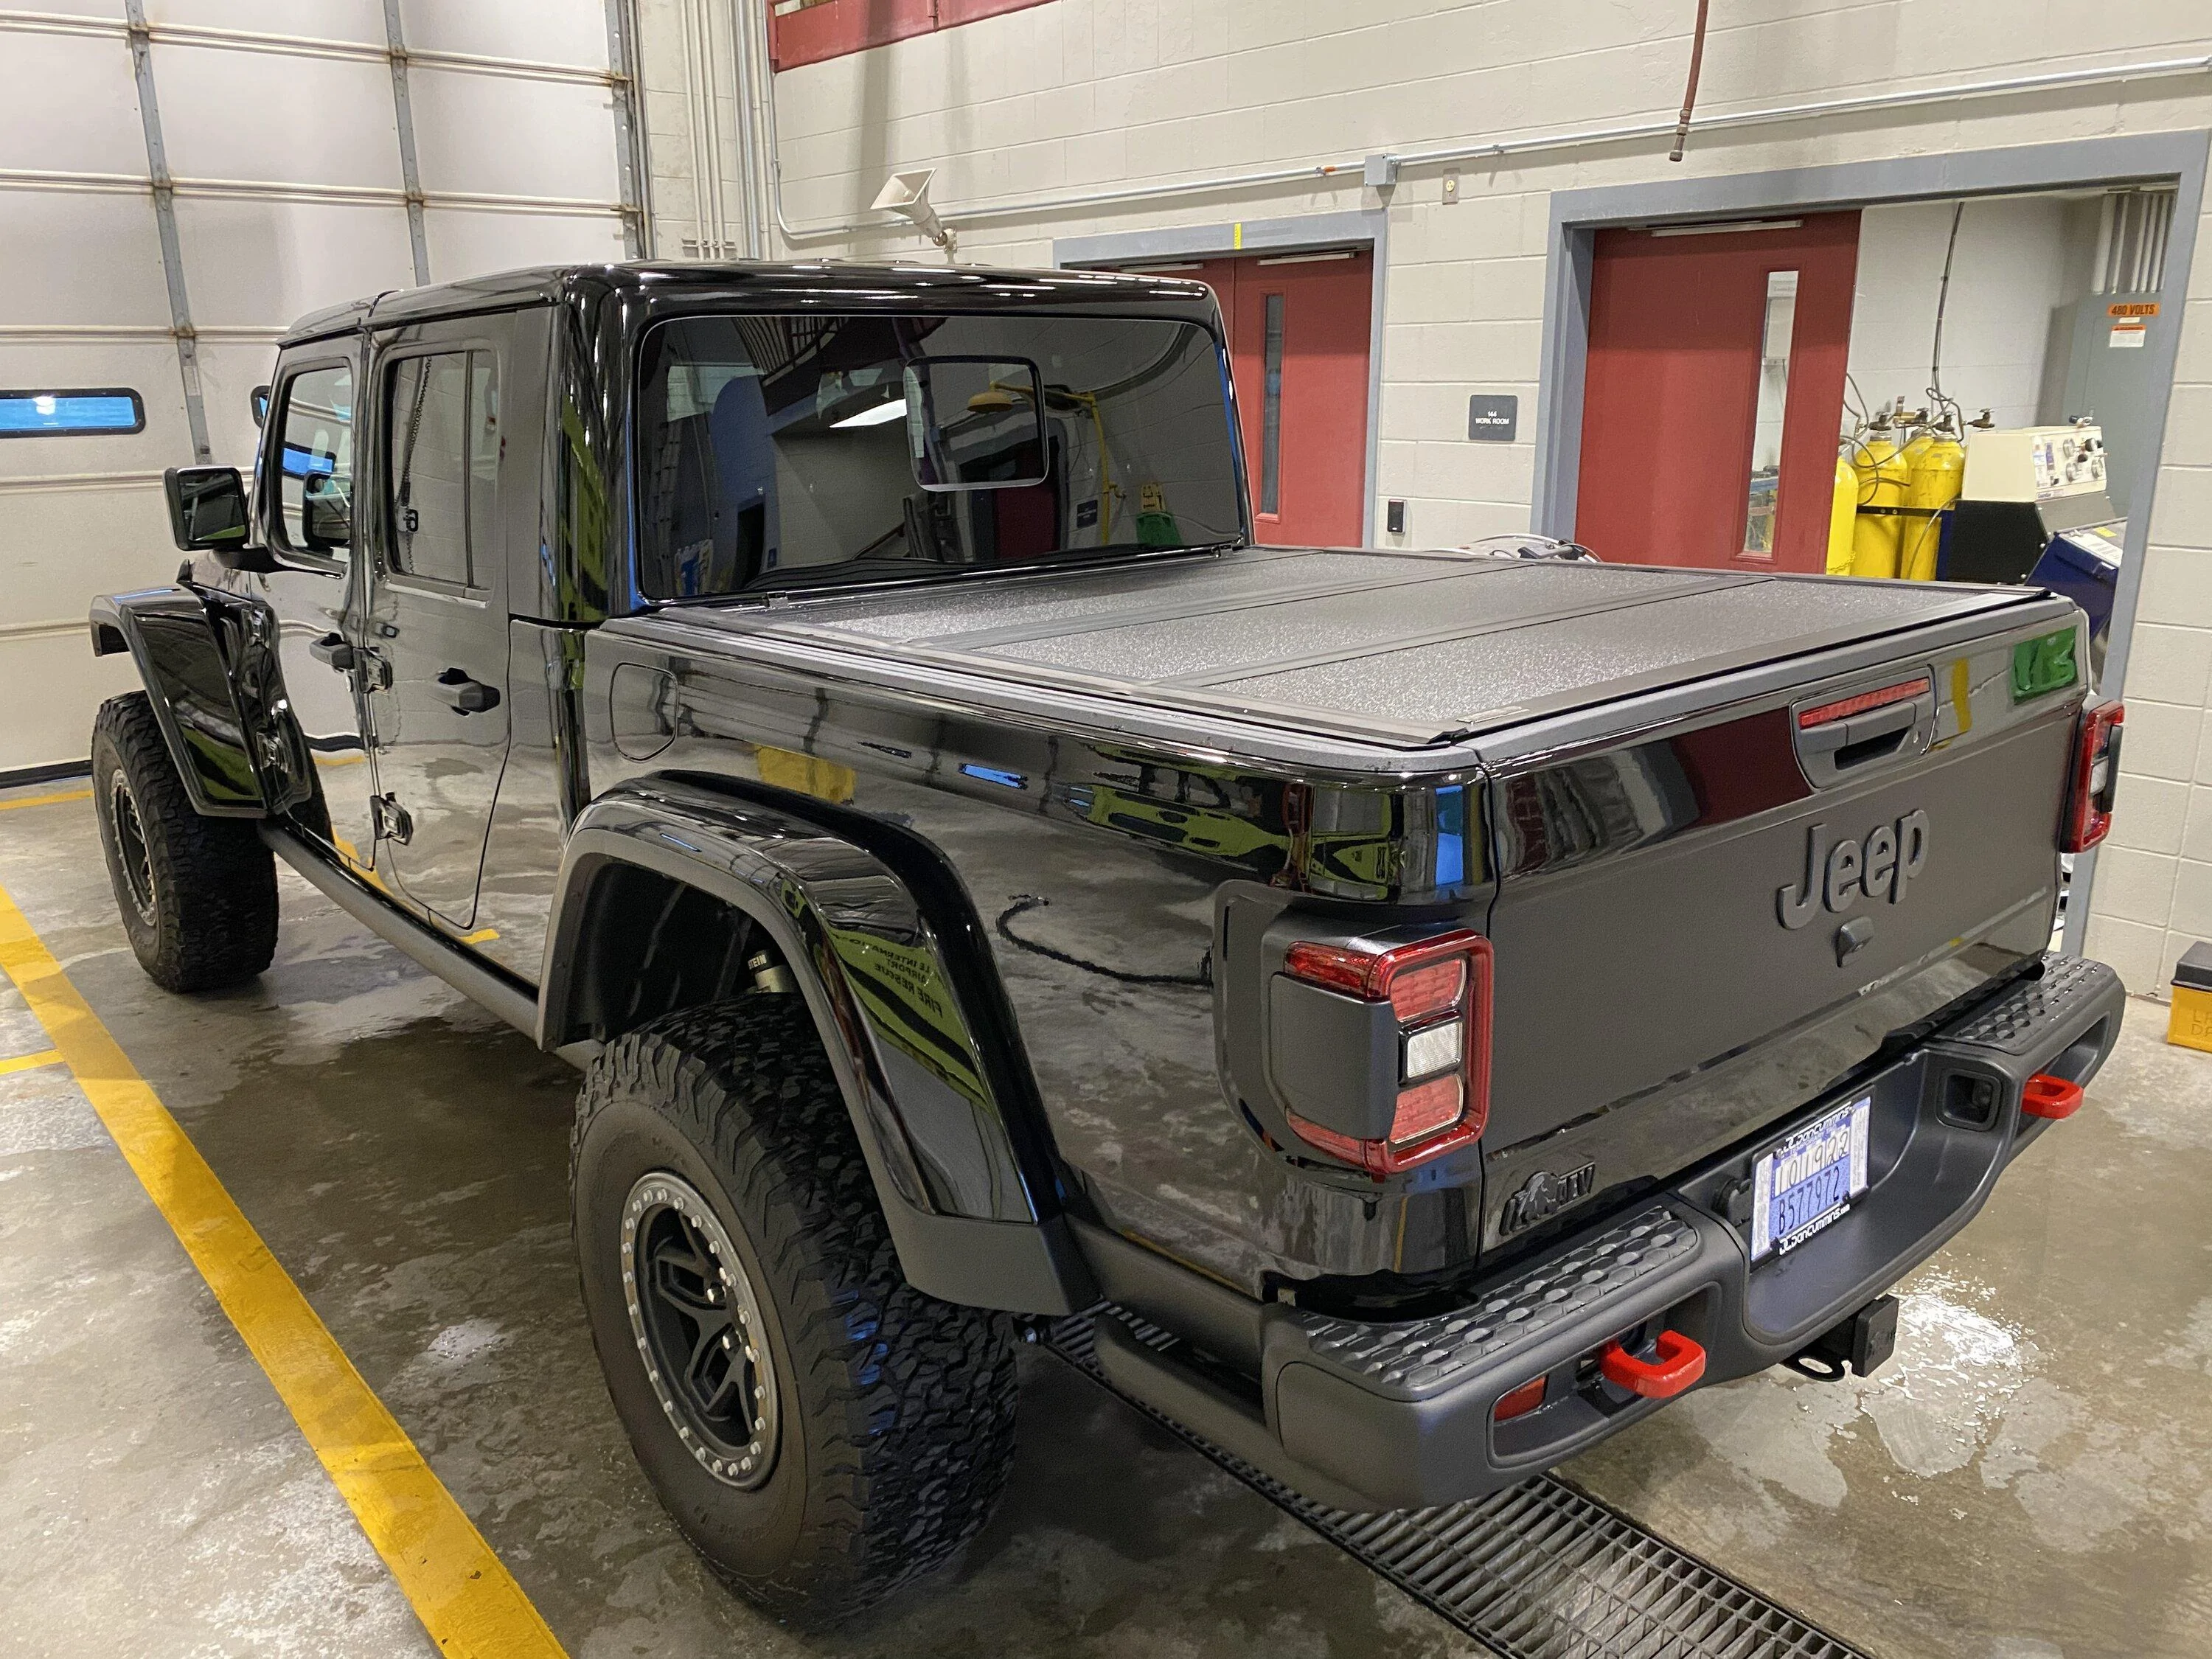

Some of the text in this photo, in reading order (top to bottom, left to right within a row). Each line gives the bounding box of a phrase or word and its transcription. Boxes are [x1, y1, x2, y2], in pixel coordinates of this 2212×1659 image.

[2111, 304, 2155, 315] 480 VOLTS
[1775, 808, 1930, 929] Jeep
[1778, 1166, 1840, 1235] B577972
